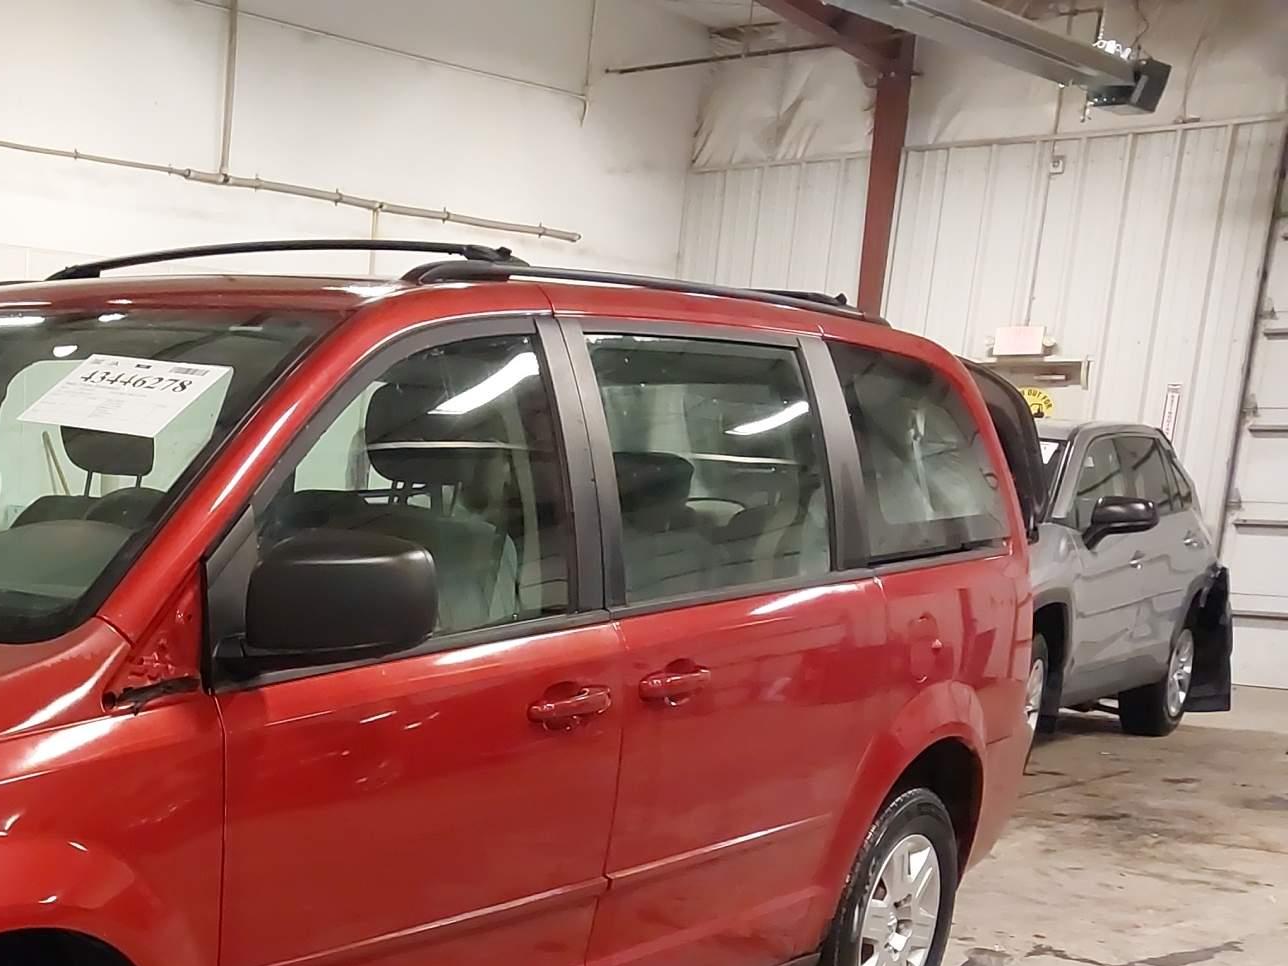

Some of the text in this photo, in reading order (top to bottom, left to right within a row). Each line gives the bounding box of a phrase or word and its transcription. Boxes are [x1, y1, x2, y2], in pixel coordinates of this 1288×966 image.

[80, 370, 193, 393] 43446278
[1027, 389, 1042, 398] OUT
[1041, 394, 1053, 409] FOR
